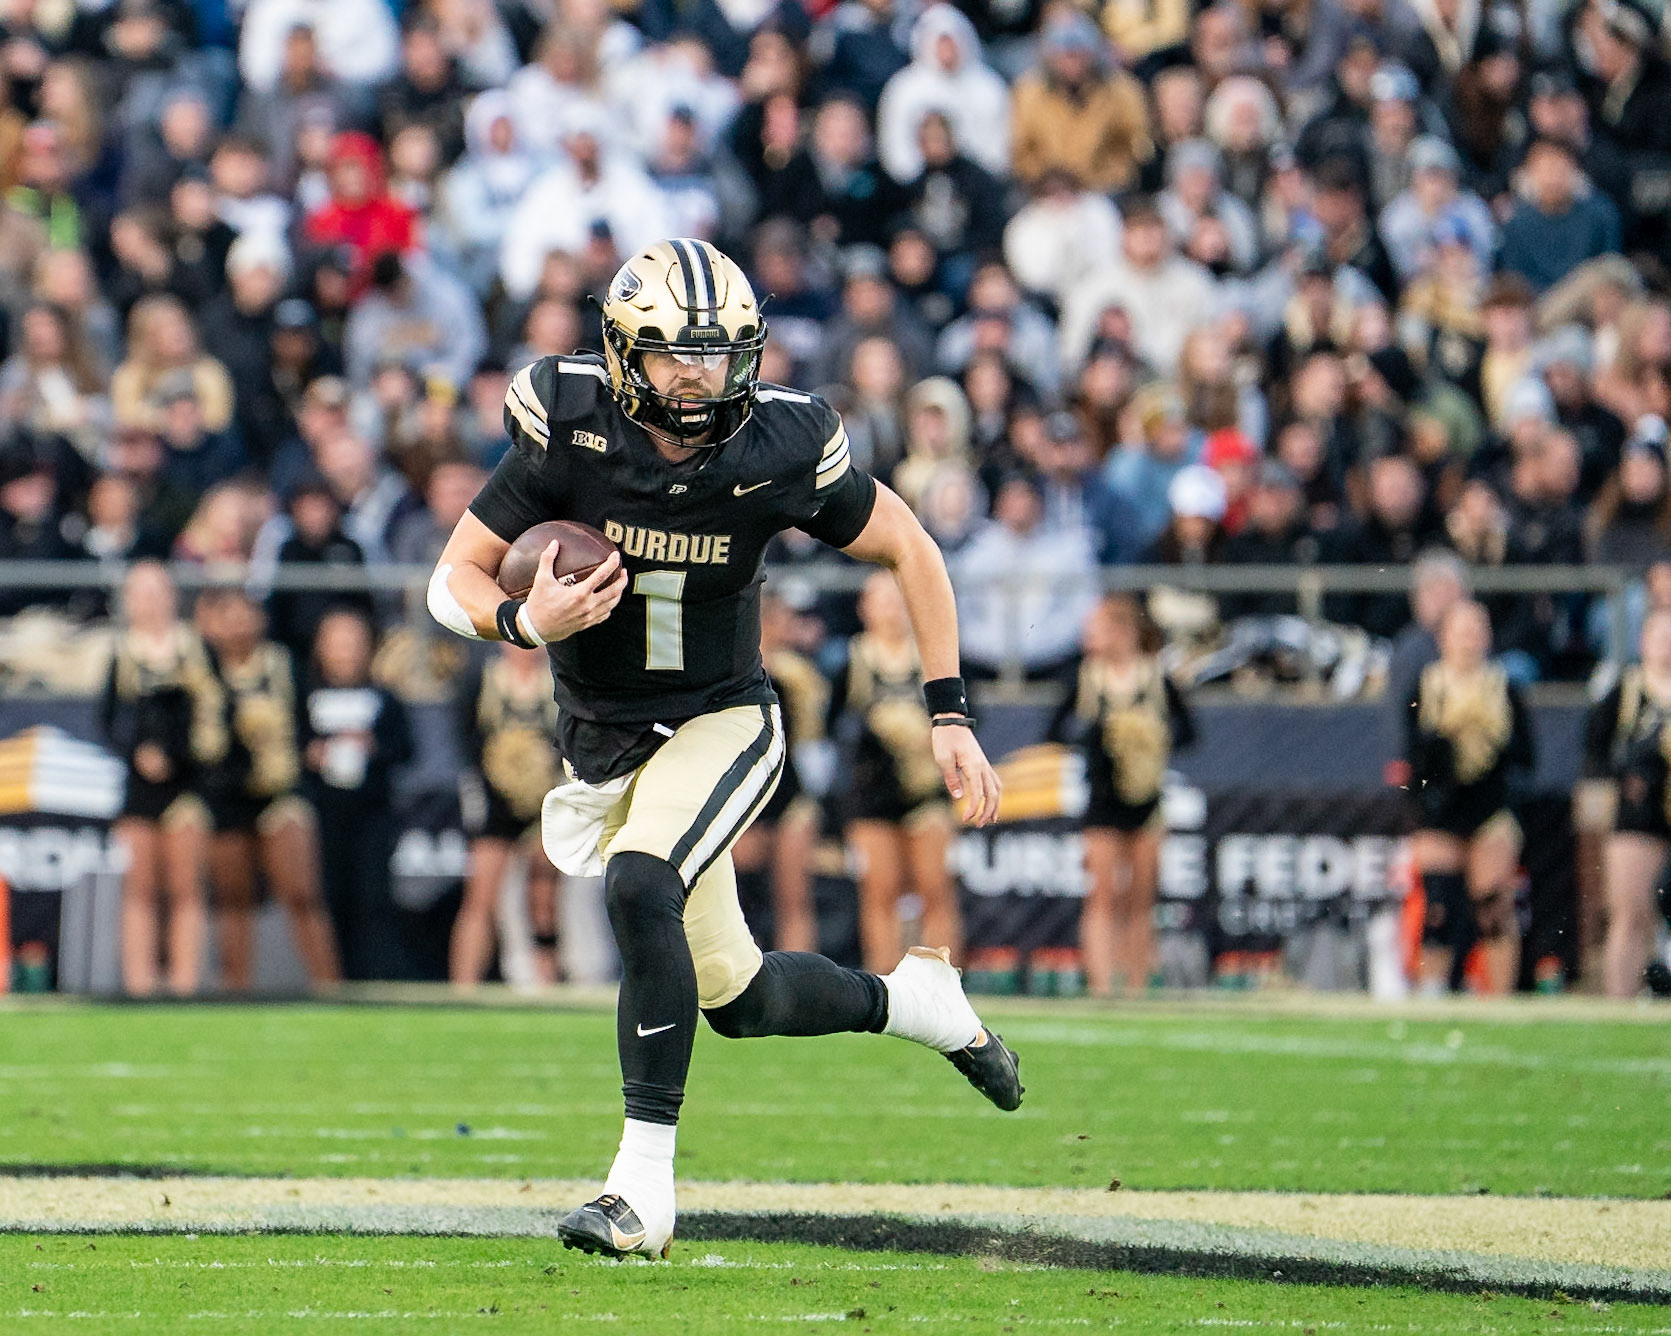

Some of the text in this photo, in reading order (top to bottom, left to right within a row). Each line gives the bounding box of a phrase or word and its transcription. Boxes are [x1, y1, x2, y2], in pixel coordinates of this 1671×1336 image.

[690, 329, 720, 339] PURDUE
[604, 519, 731, 565] PURDUE
[632, 570, 687, 671] 1
